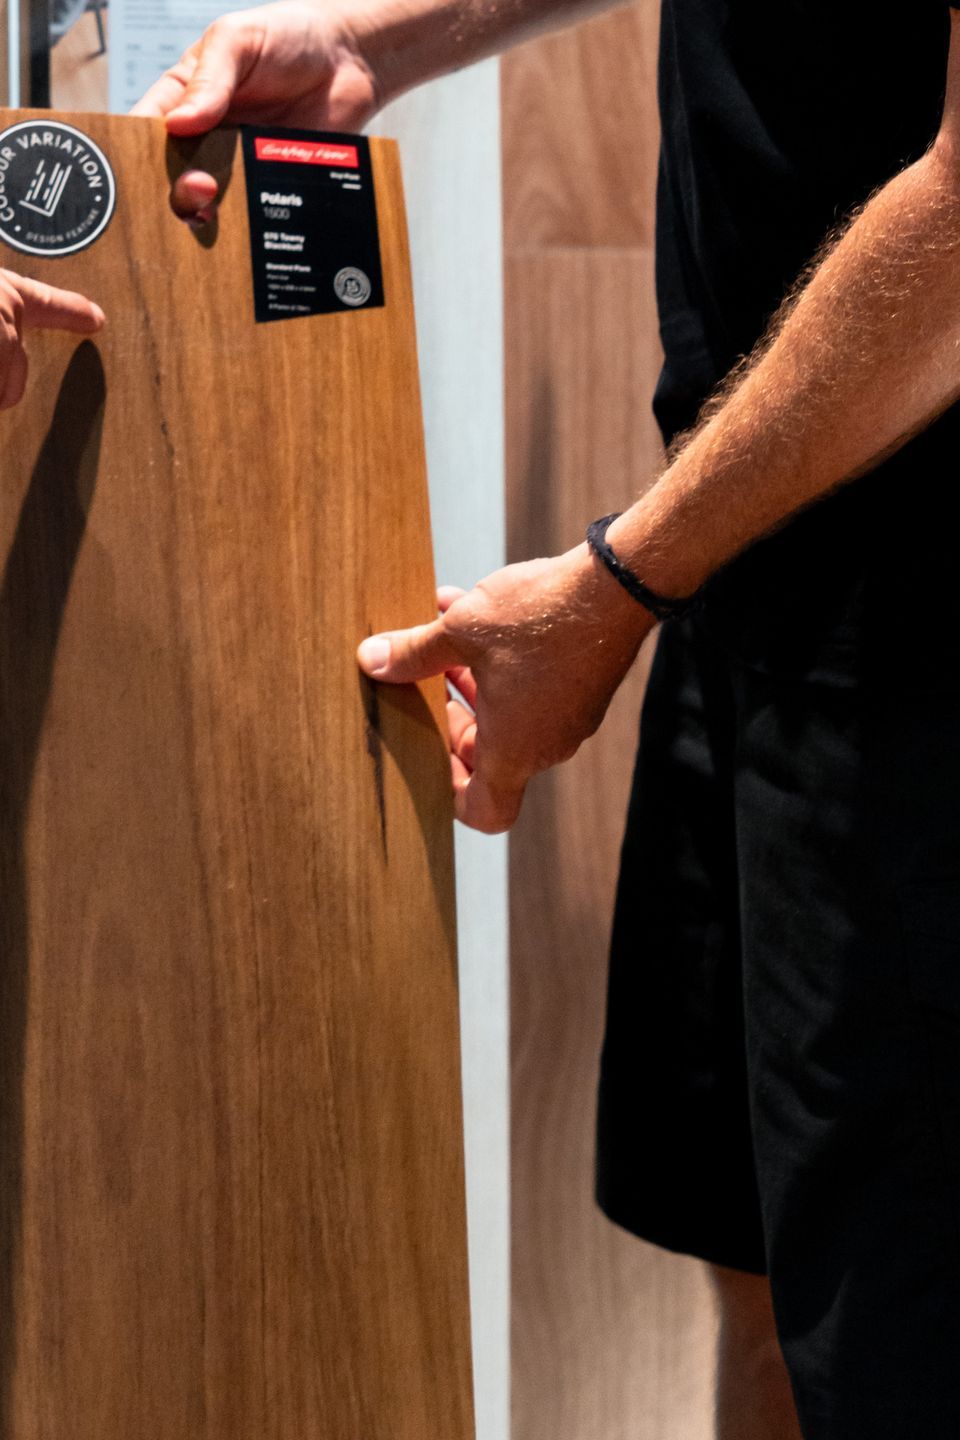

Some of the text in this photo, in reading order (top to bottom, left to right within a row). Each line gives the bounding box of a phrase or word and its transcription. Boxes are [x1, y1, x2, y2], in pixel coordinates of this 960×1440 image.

[16, 131, 103, 189] VARIATION
[260, 191, 303, 207] Polaris
[25, 208, 100, 244] DESIGN FEATURE
